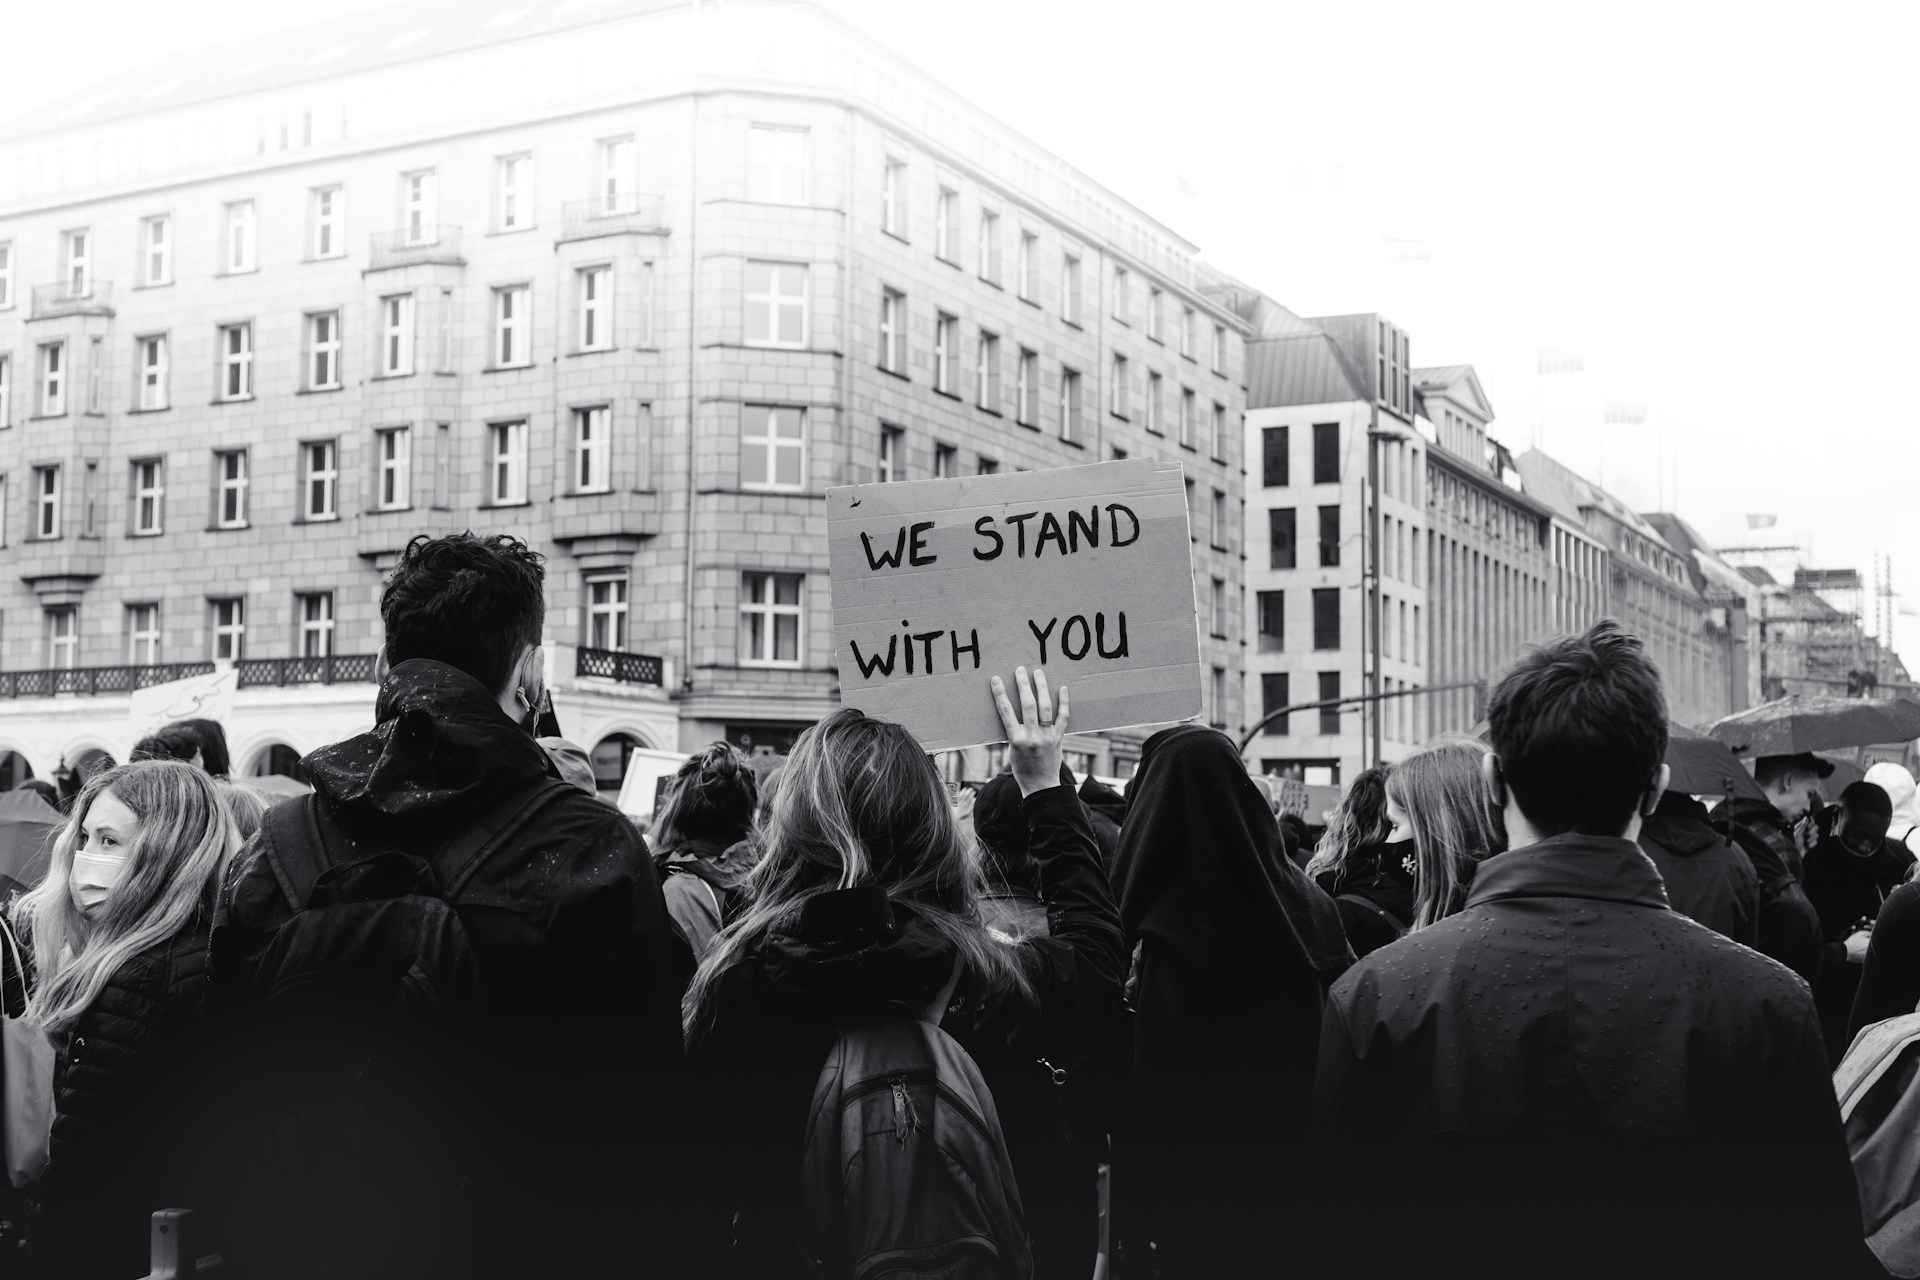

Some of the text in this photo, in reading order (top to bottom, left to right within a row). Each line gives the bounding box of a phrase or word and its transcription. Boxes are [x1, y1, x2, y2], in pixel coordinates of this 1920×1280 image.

[860, 503, 1140, 571] WE STAND
[1028, 610, 1129, 665] YOU
